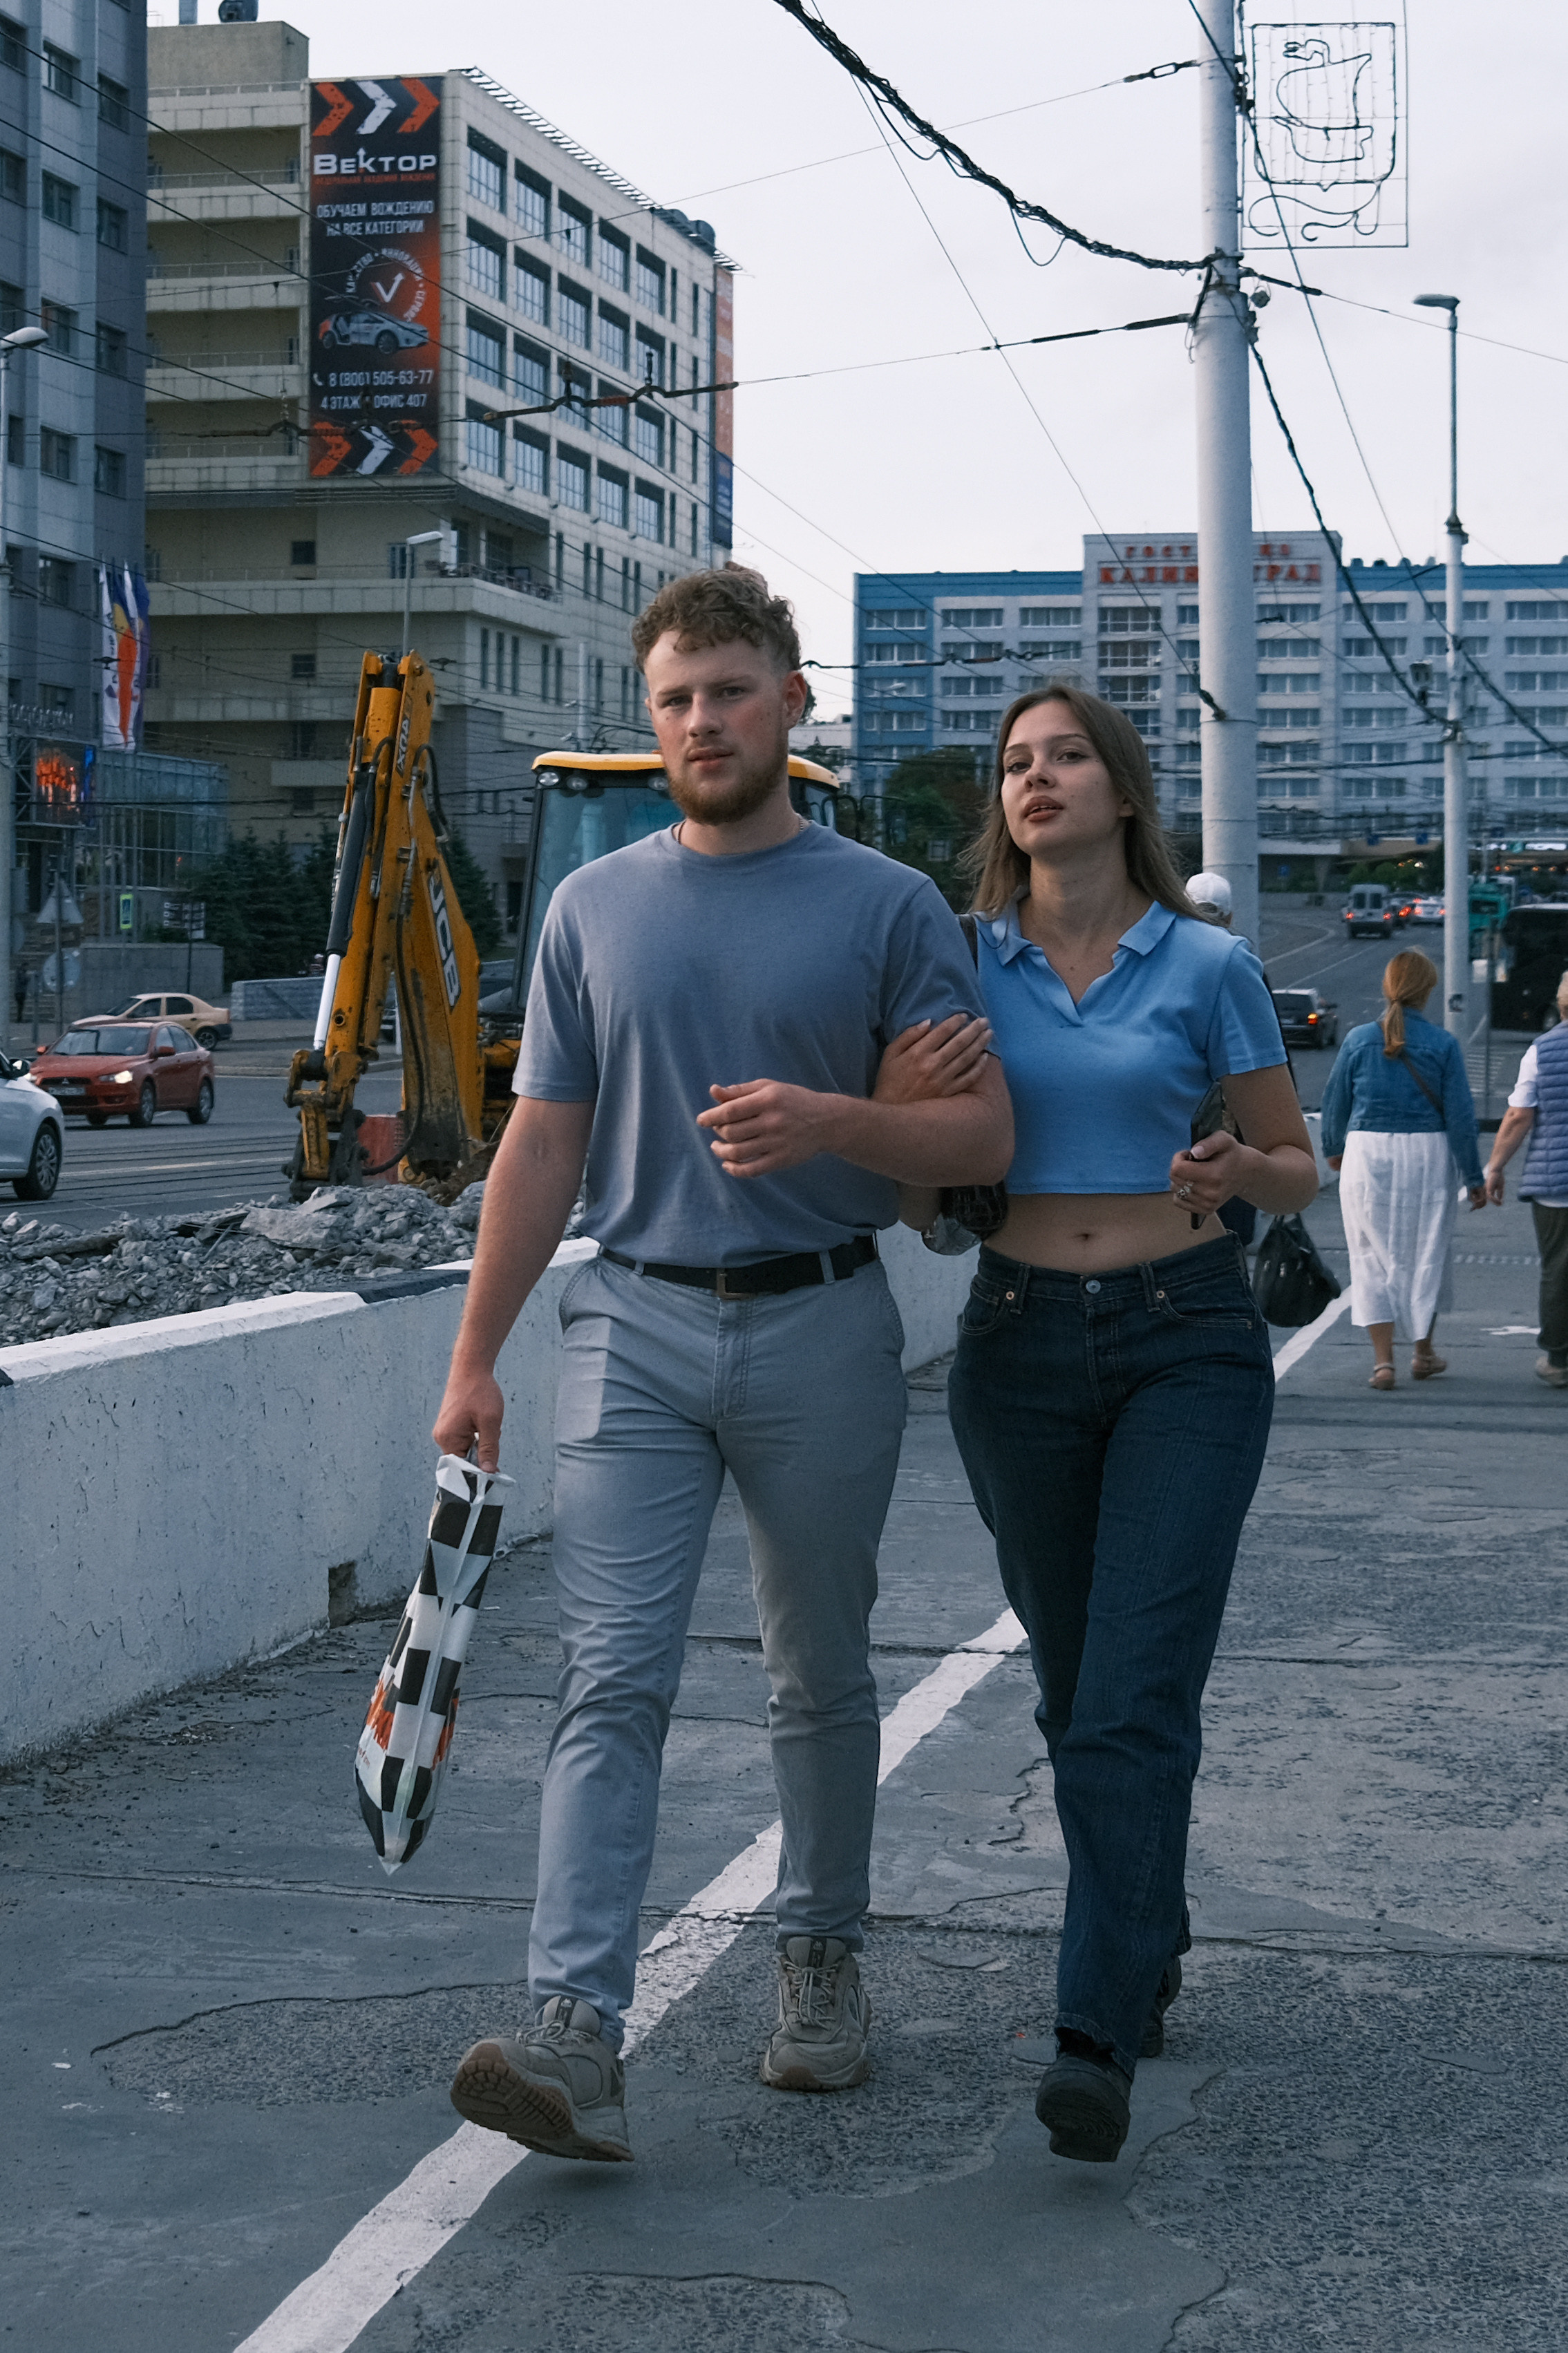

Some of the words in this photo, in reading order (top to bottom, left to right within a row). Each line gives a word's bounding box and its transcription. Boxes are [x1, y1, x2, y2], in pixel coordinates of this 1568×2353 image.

[317, 202, 367, 218] ОБУЧАЕМ
[370, 200, 434, 217] ВОЖДЕНИЮ
[326, 223, 341, 237] НА
[343, 222, 363, 236] ВСЕ
[365, 219, 424, 235] КАТЕГОРИИ
[329, 372, 337, 387] 8
[372, 369, 434, 386] 505-63-77
[321, 396, 328, 409] 4
[330, 395, 361, 410] ЭТАЖ
[374, 394, 404, 408] ОФИС
[406, 393, 427, 407] 407
[428, 876, 461, 1008] JCB
